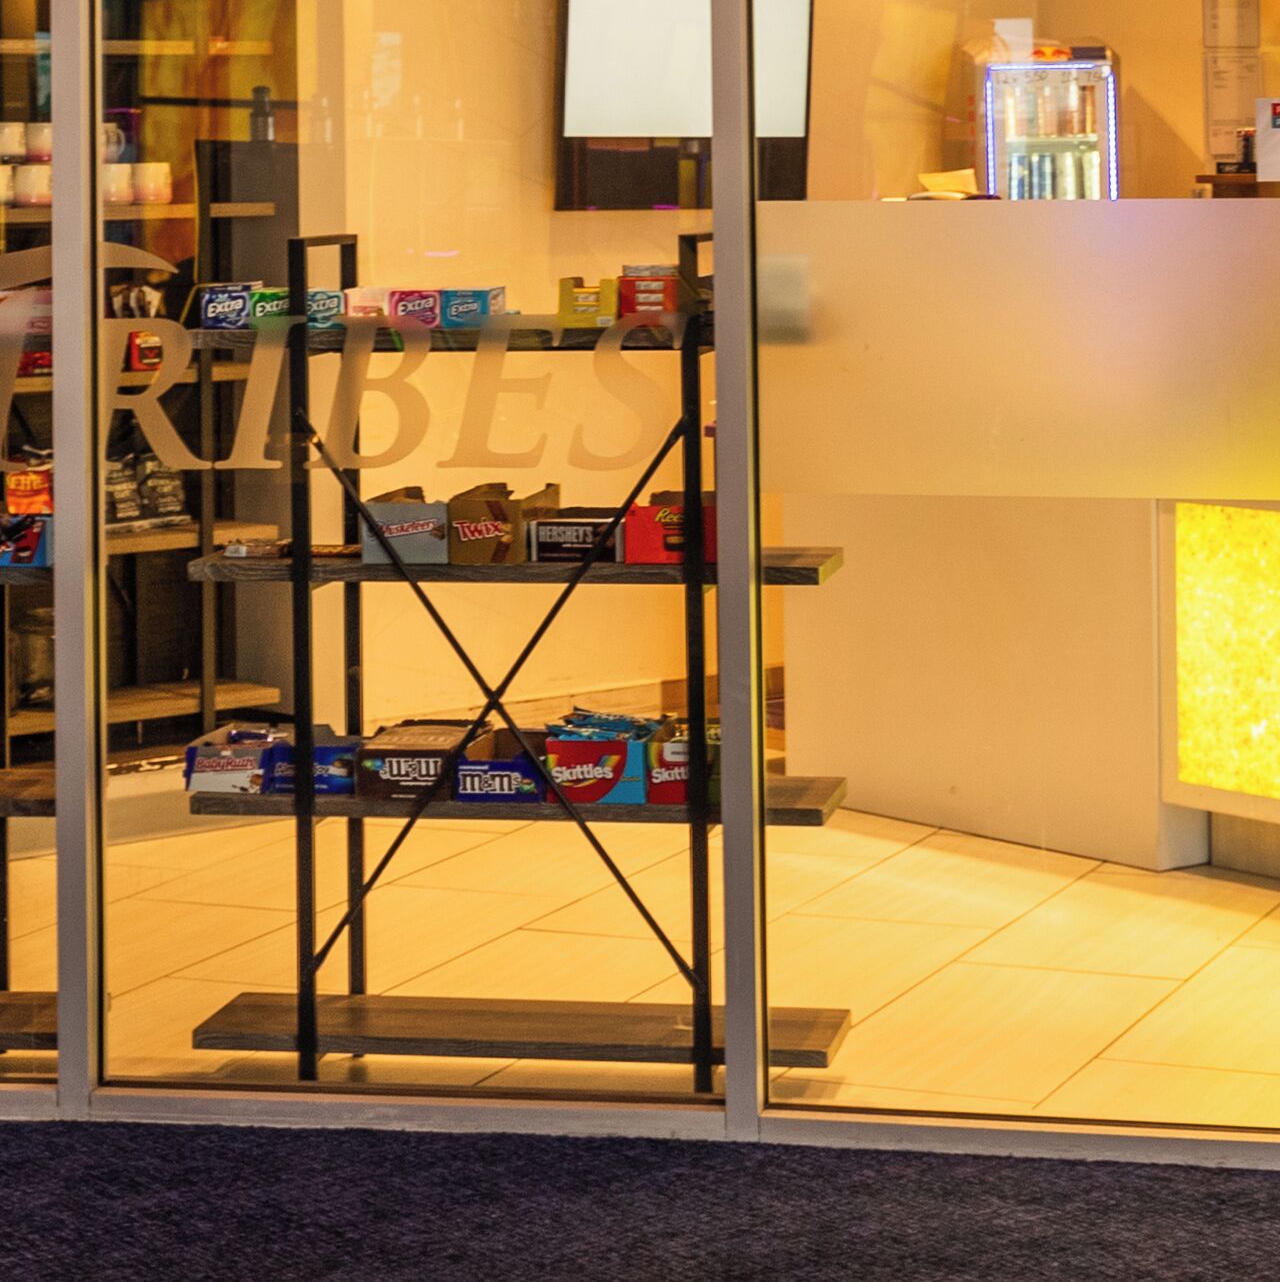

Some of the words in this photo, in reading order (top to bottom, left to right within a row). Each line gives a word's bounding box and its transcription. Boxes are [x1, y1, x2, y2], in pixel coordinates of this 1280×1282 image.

[207, 297, 244, 318] Extra
[255, 296, 290, 316] Extra
[396, 296, 434, 317] Extra
[449, 301, 479, 317] Extra
[453, 521, 505, 542] Twix
[551, 765, 613, 783] Skittles
